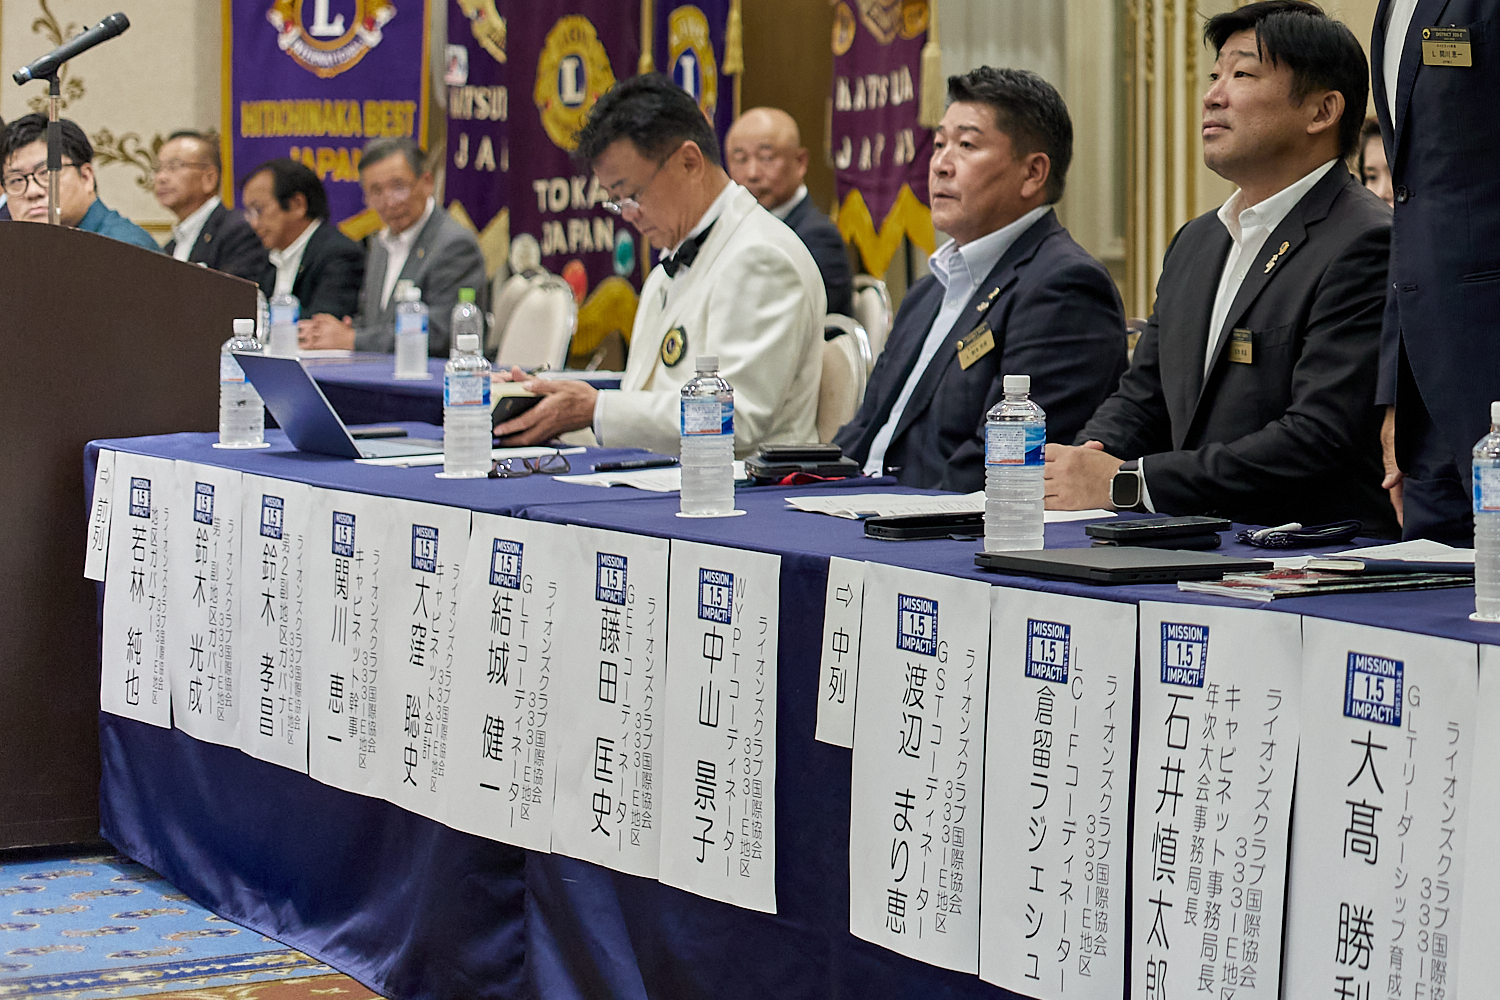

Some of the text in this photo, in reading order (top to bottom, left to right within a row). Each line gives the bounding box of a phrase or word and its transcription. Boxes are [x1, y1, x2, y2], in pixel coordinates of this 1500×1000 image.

[560, 56, 586, 106] L
[533, 176, 610, 213] TOKA
[502, 555, 512, 573] 1.5
[601, 554, 624, 569] MISSION
[261, 543, 278, 626] 鈴木
[607, 569, 617, 588] 1.5
[703, 571, 730, 587] MISSION
[710, 586, 722, 606] 1.5
[902, 597, 933, 614] MISSION
[125, 524, 147, 706] 若林 純也
[188, 527, 208, 714] 鈴木 光成
[702, 605, 728, 622] IMPACT!
[909, 614, 925, 636] 1.5
[902, 635, 931, 654] IMPACT!
[1033, 621, 1066, 639] MISSION
[1168, 624, 1203, 642] MISSION
[327, 558, 350, 743] 関川 恵一
[828, 627, 849, 704] 中列
[1041, 639, 1056, 663] 1.5
[1176, 642, 1193, 666] 1.5
[1355, 655, 1396, 676] MISSION
[403, 576, 431, 787] 大窪 聡史
[1031, 661, 1064, 681] IMPACT!
[1167, 667, 1199, 685] IMPACT!
[479, 590, 513, 792] 結城 健一
[1365, 676, 1385, 702] 1.5
[591, 605, 621, 836] 藤田 匡史
[1352, 701, 1394, 723] IMPACT!
[693, 626, 724, 863] 中山 景子
[885, 661, 928, 934] 渡辺 まり恵
[948, 650, 976, 915] ライオンズクラブ国際協会
[1094, 674, 1118, 956] ライオンズクラブ国際協会
[1183, 681, 1220, 926] 年次大会事務局長
[1145, 692, 1194, 1000] 石井慎太郎
[1197, 684, 1241, 993] キャビネット事務局長
[1238, 689, 1283, 990] ライオンズクラブ国際協会
